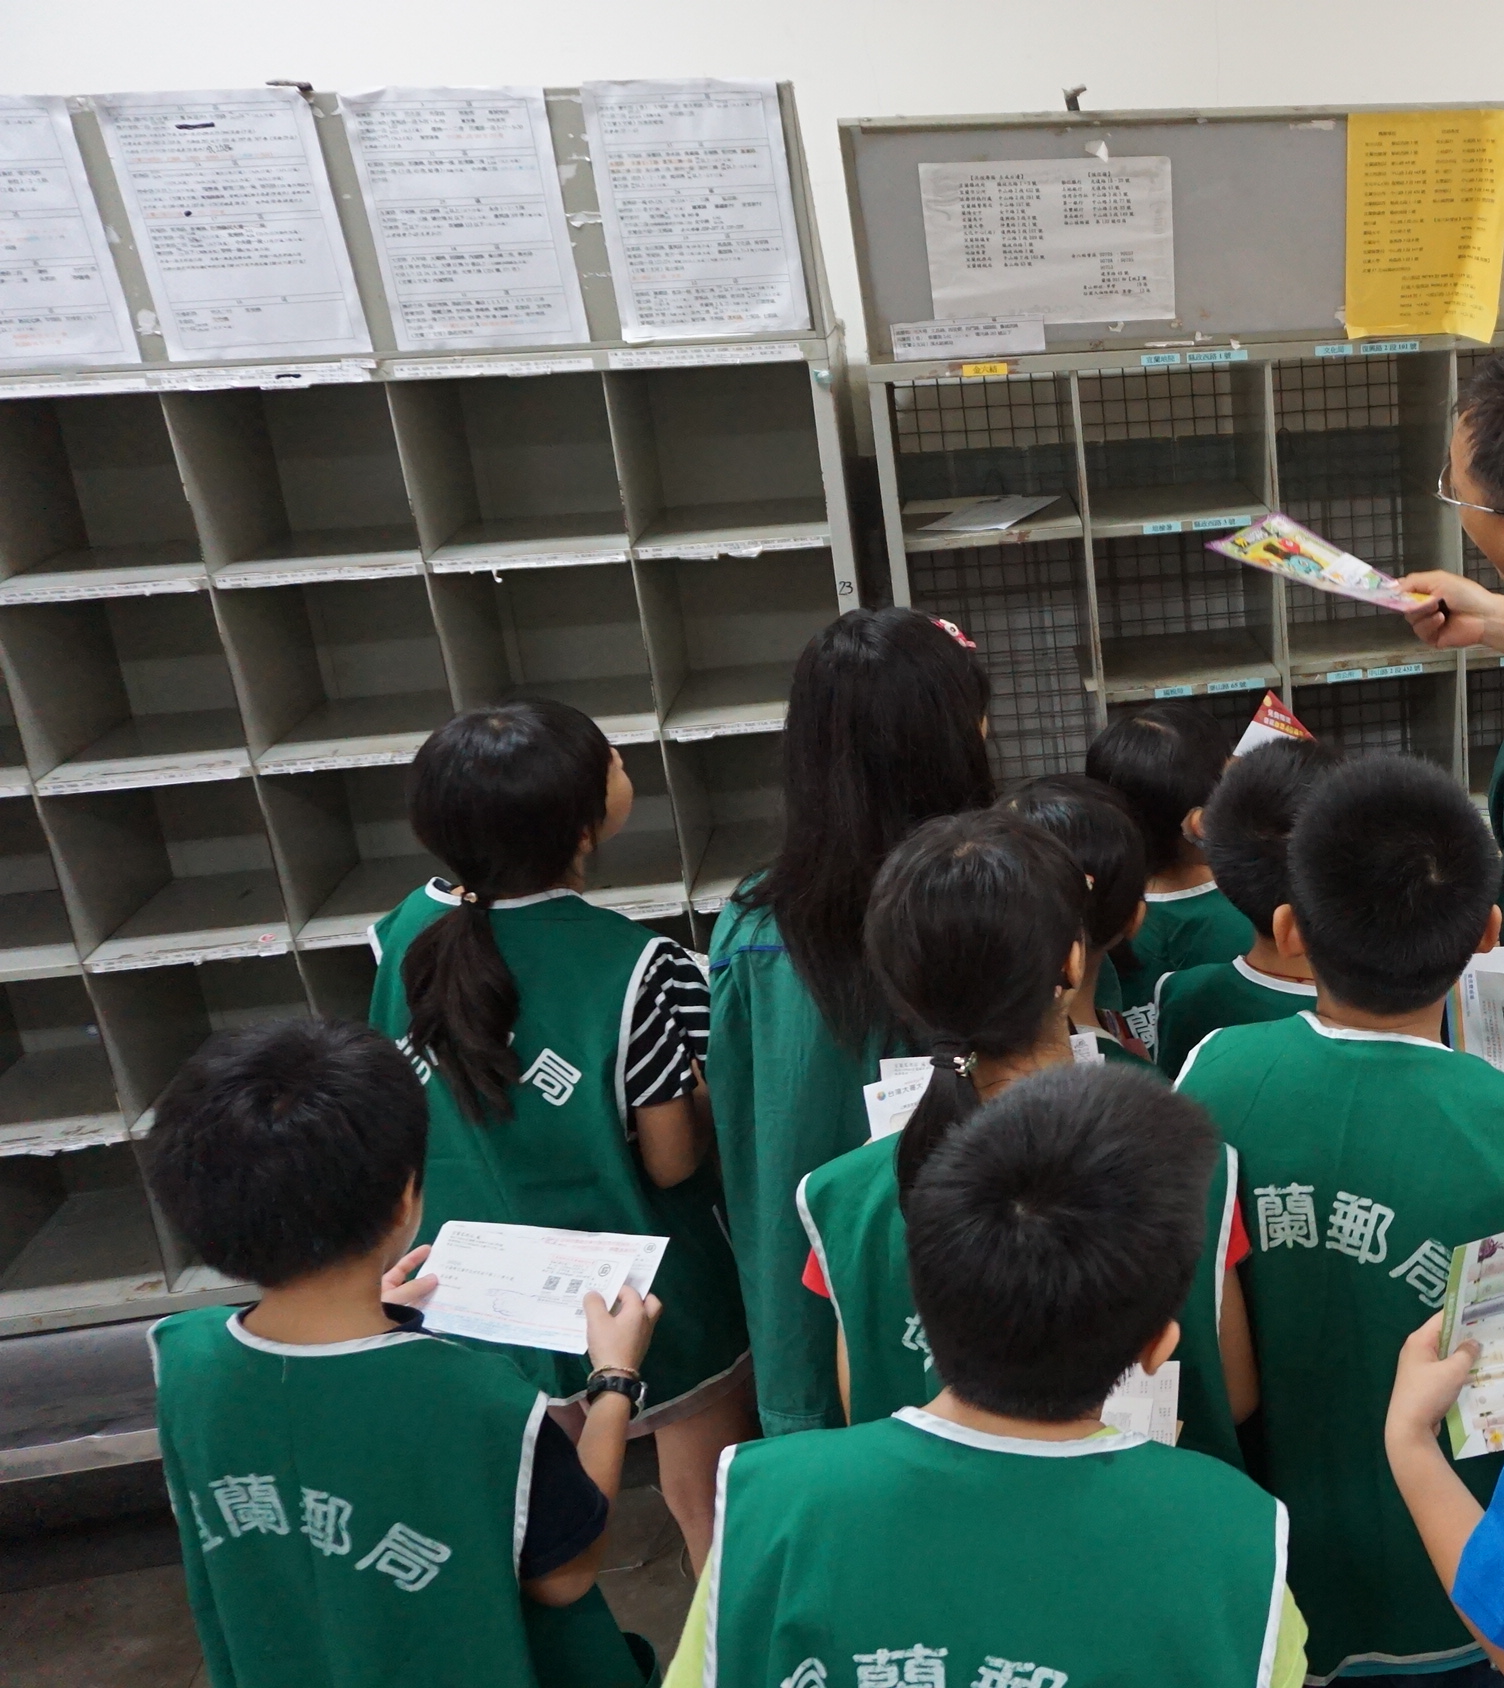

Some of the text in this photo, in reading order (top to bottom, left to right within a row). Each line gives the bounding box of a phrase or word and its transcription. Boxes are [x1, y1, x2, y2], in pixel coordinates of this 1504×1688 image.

[972, 365, 998, 374] 金六結
[838, 580, 854, 597] 23
[887, 1082, 924, 1098] 台灣大哥大
